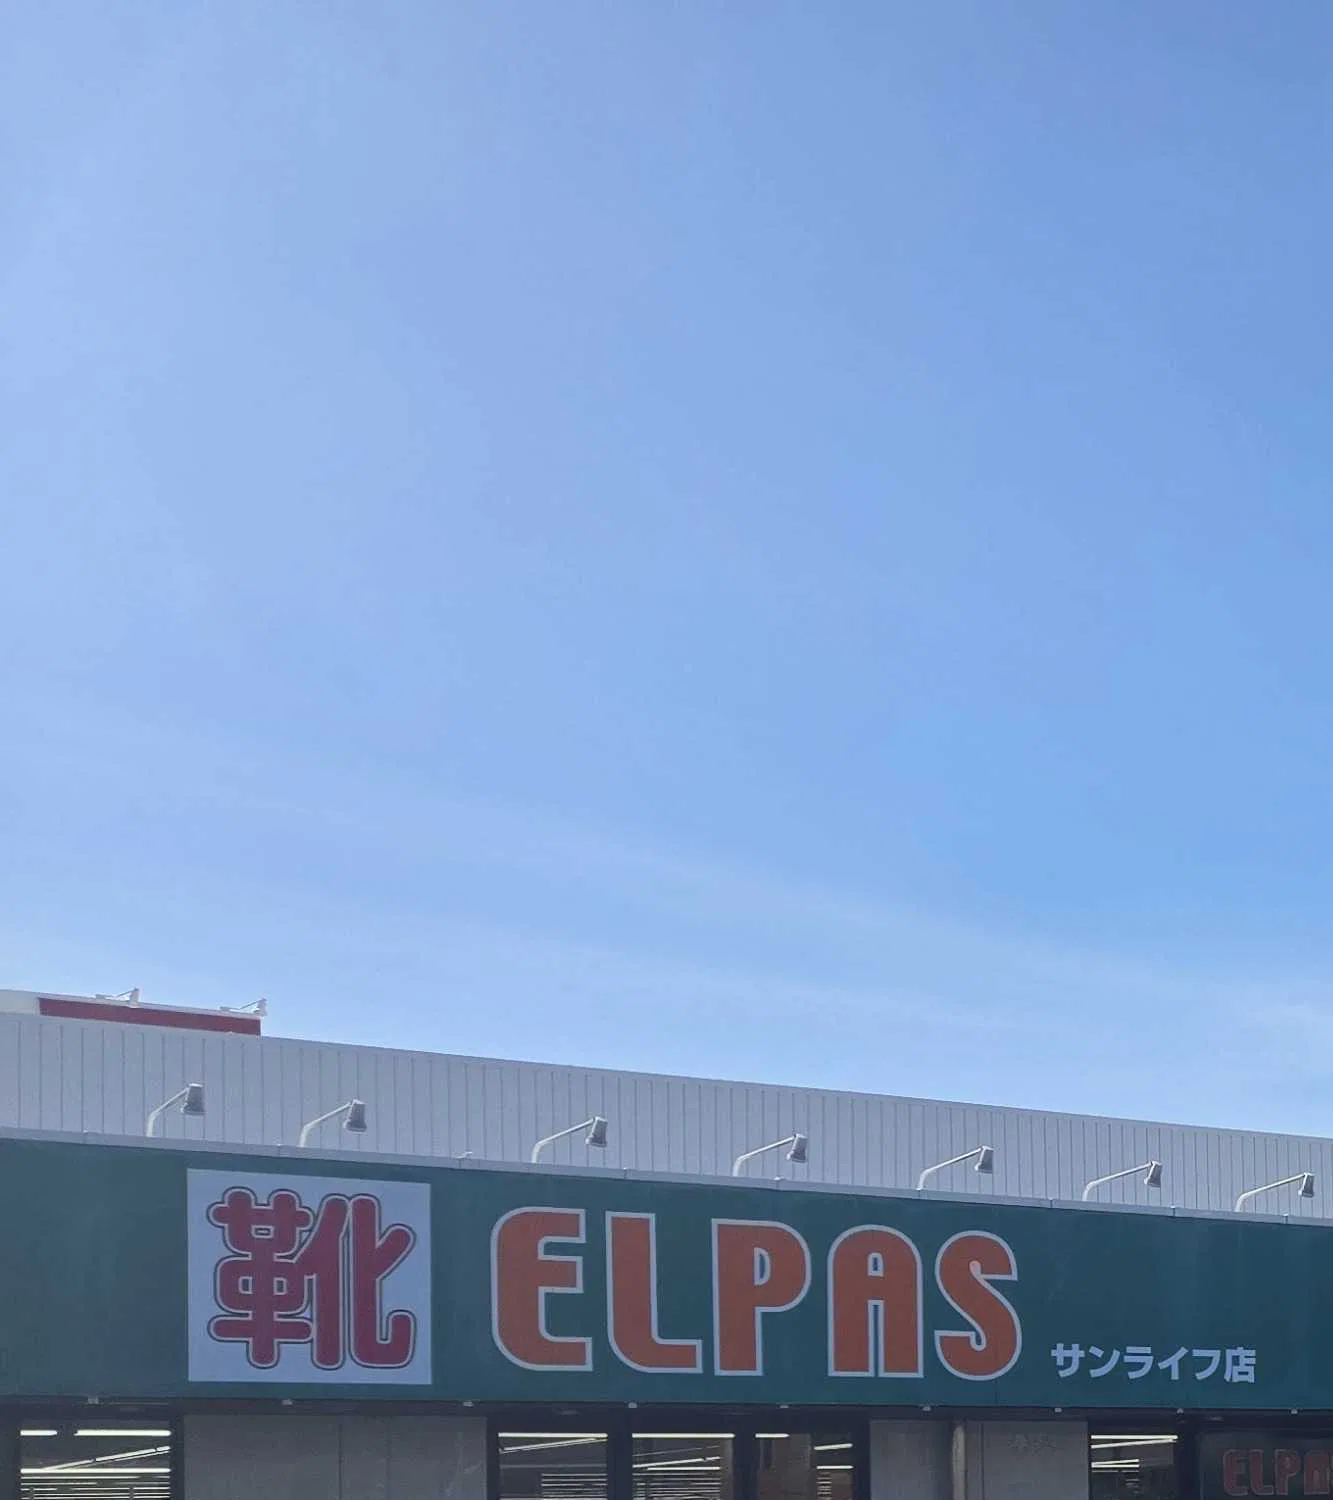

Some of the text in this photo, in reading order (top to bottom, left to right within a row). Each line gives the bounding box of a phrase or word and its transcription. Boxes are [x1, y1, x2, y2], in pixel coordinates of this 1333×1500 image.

[206, 1185, 417, 1370] 靴
[490, 1206, 1023, 1381] ELPAS
[1050, 1342, 1257, 1384] サンライフ店
